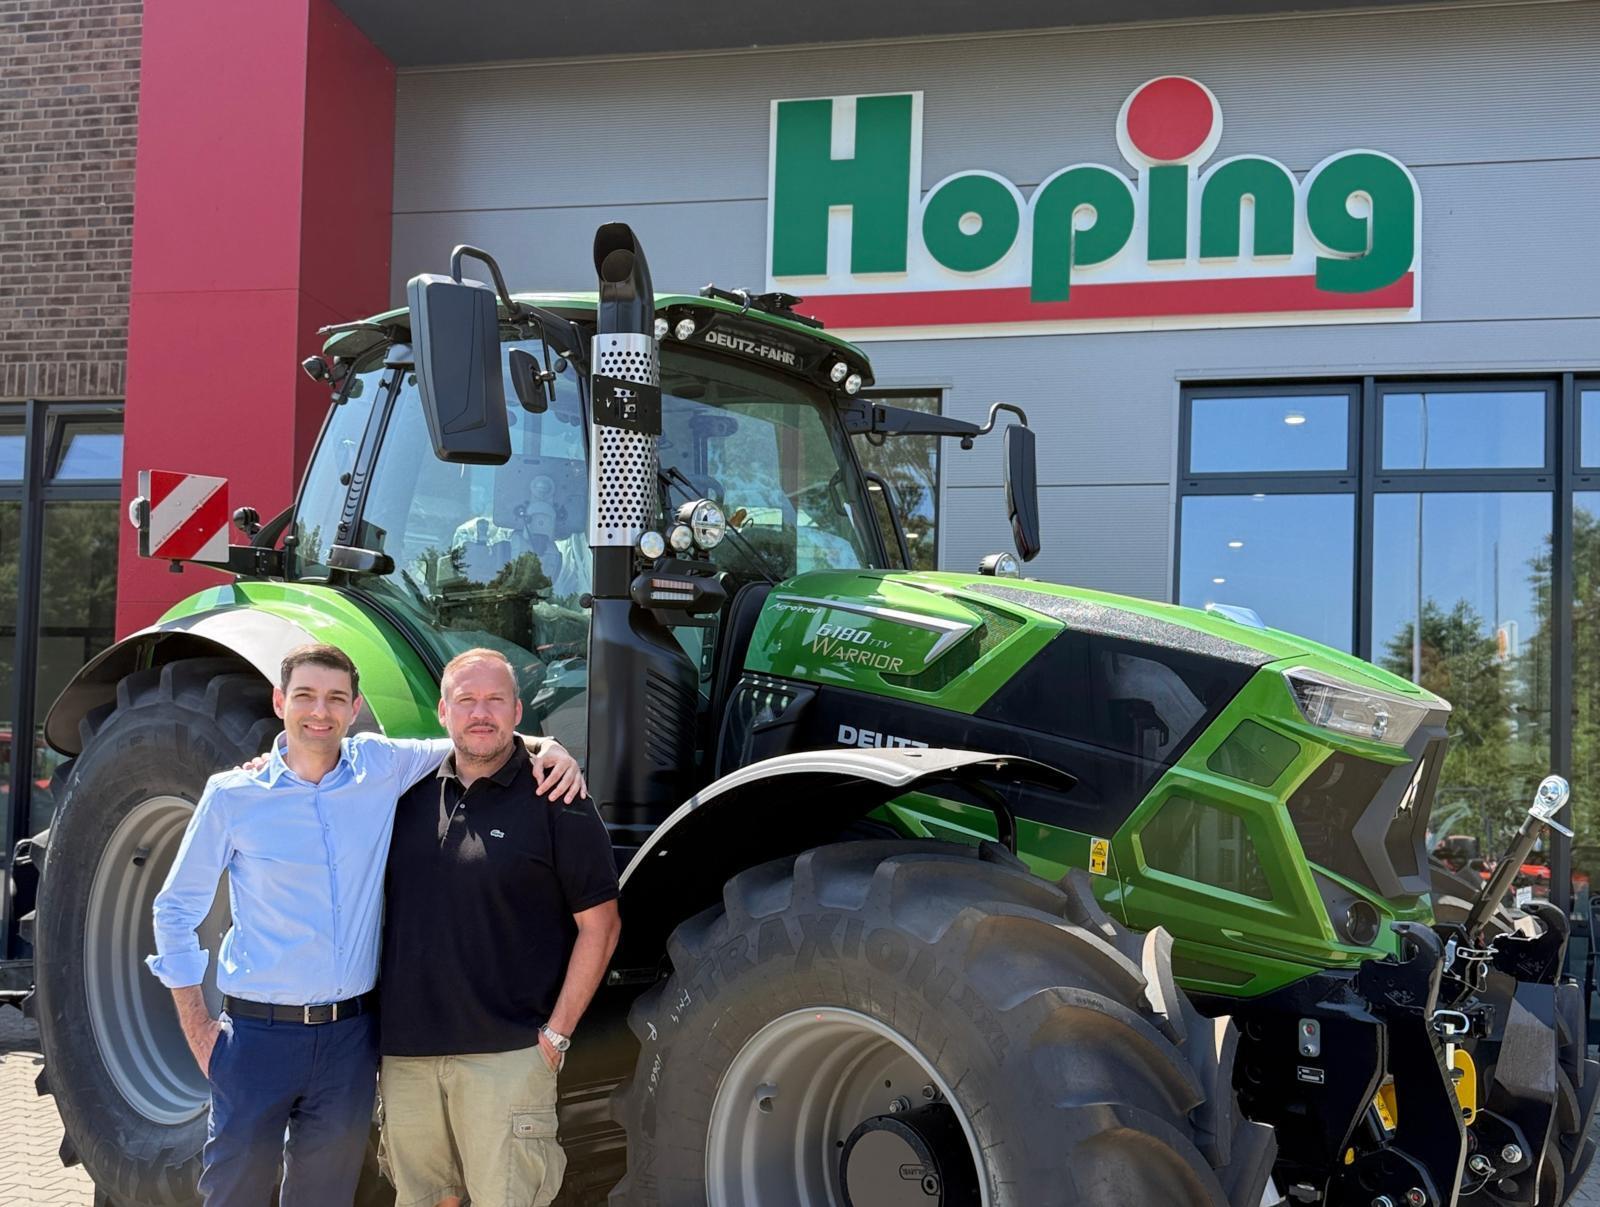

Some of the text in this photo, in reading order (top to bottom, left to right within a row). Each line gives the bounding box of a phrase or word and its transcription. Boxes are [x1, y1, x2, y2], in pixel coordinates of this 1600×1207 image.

[770, 75, 1415, 303] Hoping
[705, 331, 796, 366] DEUTZ-FAHR
[767, 602, 821, 615] Agrotron
[812, 634, 904, 673] WARRIOR
[816, 623, 893, 650] 6180 TTV
